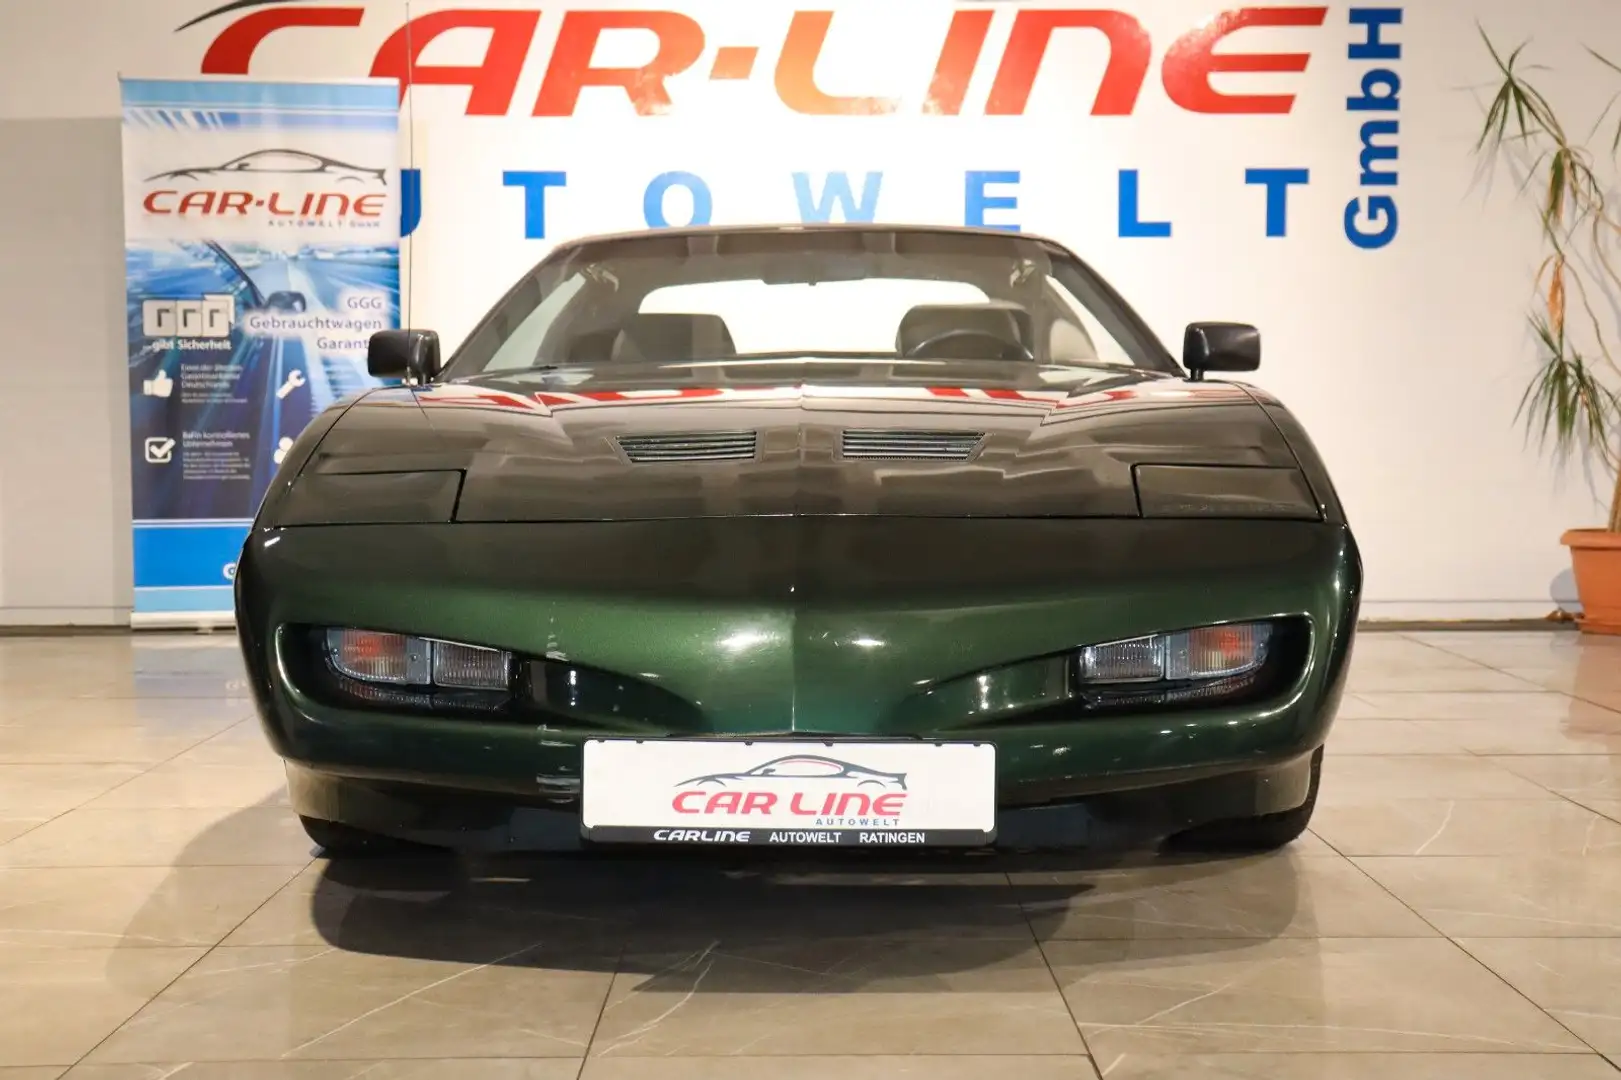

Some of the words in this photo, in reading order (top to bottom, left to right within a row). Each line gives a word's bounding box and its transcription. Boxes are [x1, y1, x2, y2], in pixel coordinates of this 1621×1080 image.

[1344, 7, 1403, 250] GmbH
[347, 296, 382, 309] GGG
[250, 316, 382, 332] Gebrauchtwagen
[317, 337, 370, 350] Garant
[672, 791, 778, 814] CAR
[790, 792, 907, 815] LINE
[815, 818, 900, 826] AUTOWELT
[653, 829, 751, 842] CARLINE
[769, 831, 842, 843] AUTOWELT
[859, 832, 926, 843] RATINGEN
